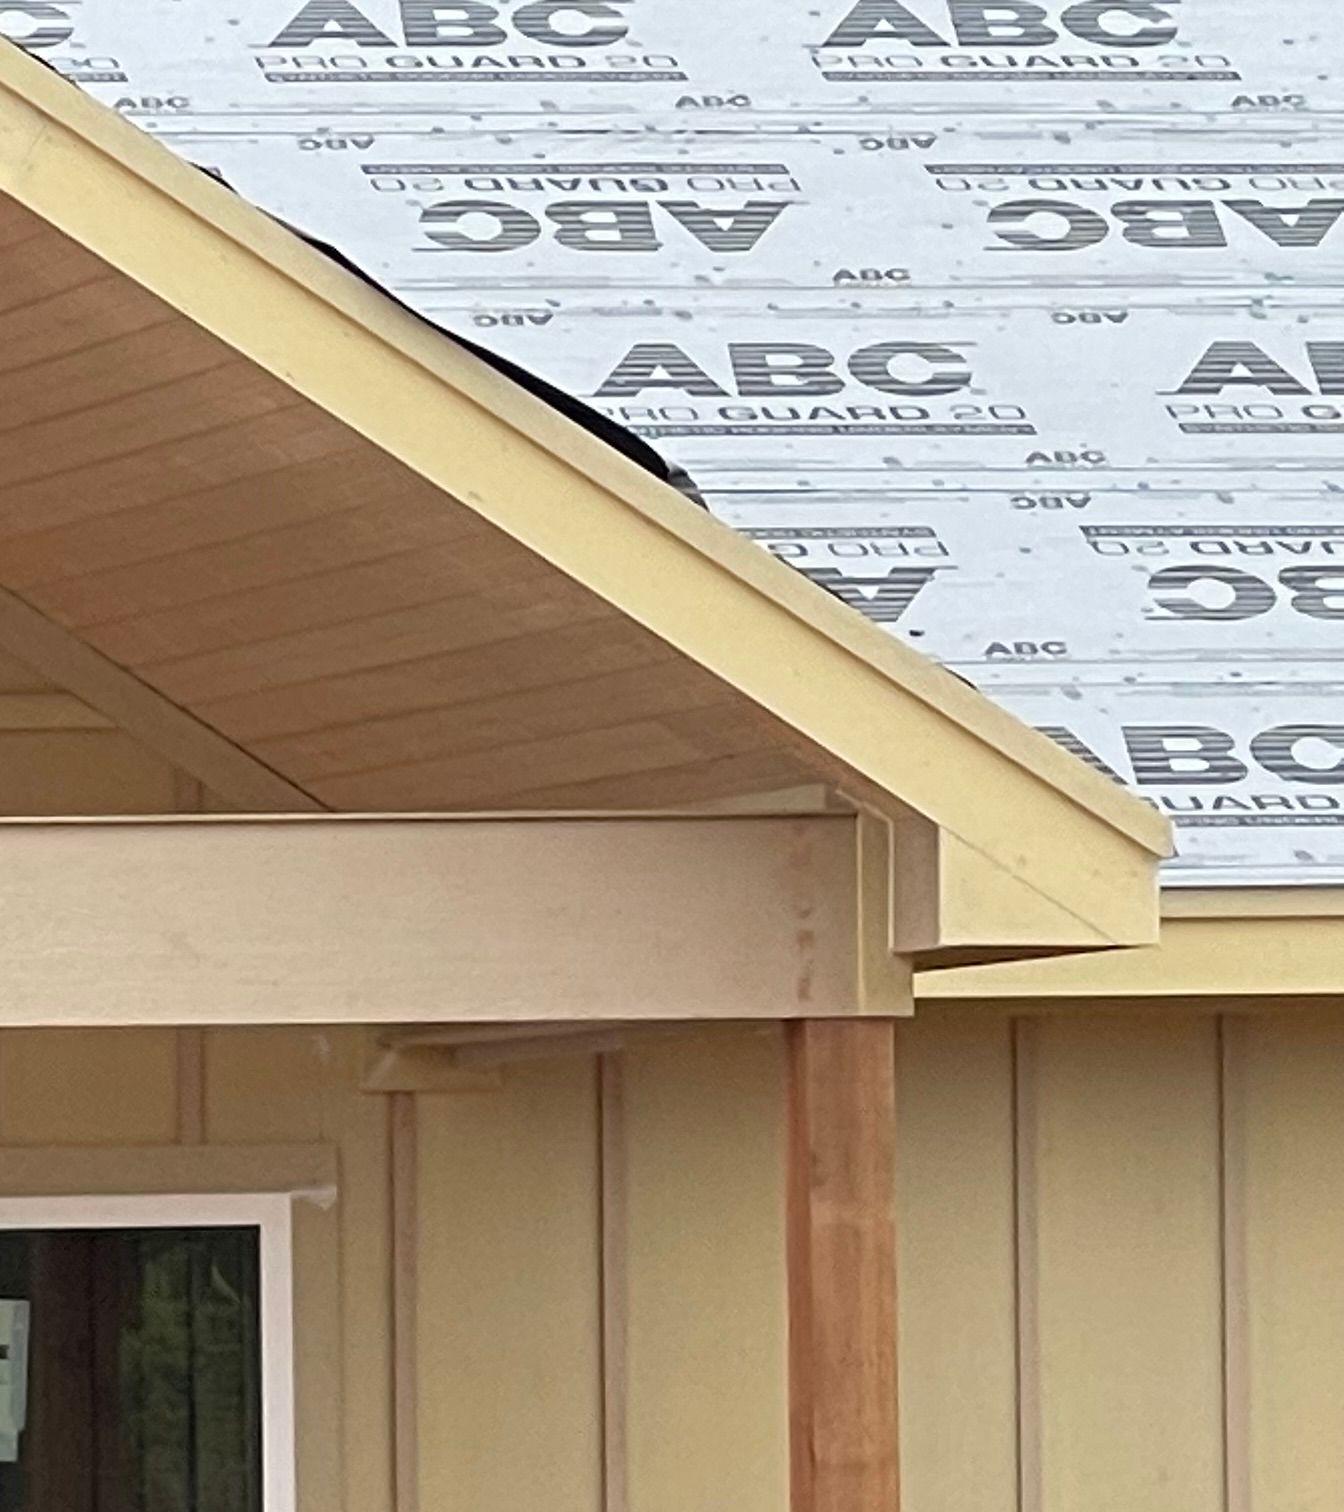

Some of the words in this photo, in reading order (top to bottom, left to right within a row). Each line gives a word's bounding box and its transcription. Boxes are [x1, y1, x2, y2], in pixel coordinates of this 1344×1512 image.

[248, 0, 644, 47] ABC
[804, 0, 1184, 48] ABC
[255, 55, 368, 70] PRO
[385, 55, 587, 69] GUARD
[605, 55, 679, 69] 20
[811, 54, 923, 69] PRO
[940, 55, 1139, 69] GUARD
[1158, 55, 1231, 69] 20
[115, 96, 191, 110] ABC
[675, 95, 752, 108] ABC
[1231, 94, 1306, 108] ABC
[464, 176, 670, 193] GUARD
[687, 176, 802, 193] PRO
[1028, 177, 1234, 193] GUARD
[412, 199, 810, 251] ABC
[983, 198, 1344, 252] ABC
[832, 268, 911, 282] ABC
[582, 341, 978, 397] ABC
[607, 404, 699, 421] RO
[717, 405, 931, 421] GUARD
[948, 404, 1027, 421] 20
[1164, 404, 1285, 420] PRO
[1026, 450, 1107, 465] ABC
[827, 541, 950, 557] PRO
[984, 640, 1068, 656] ABC
[1141, 795, 1340, 811] UARD
